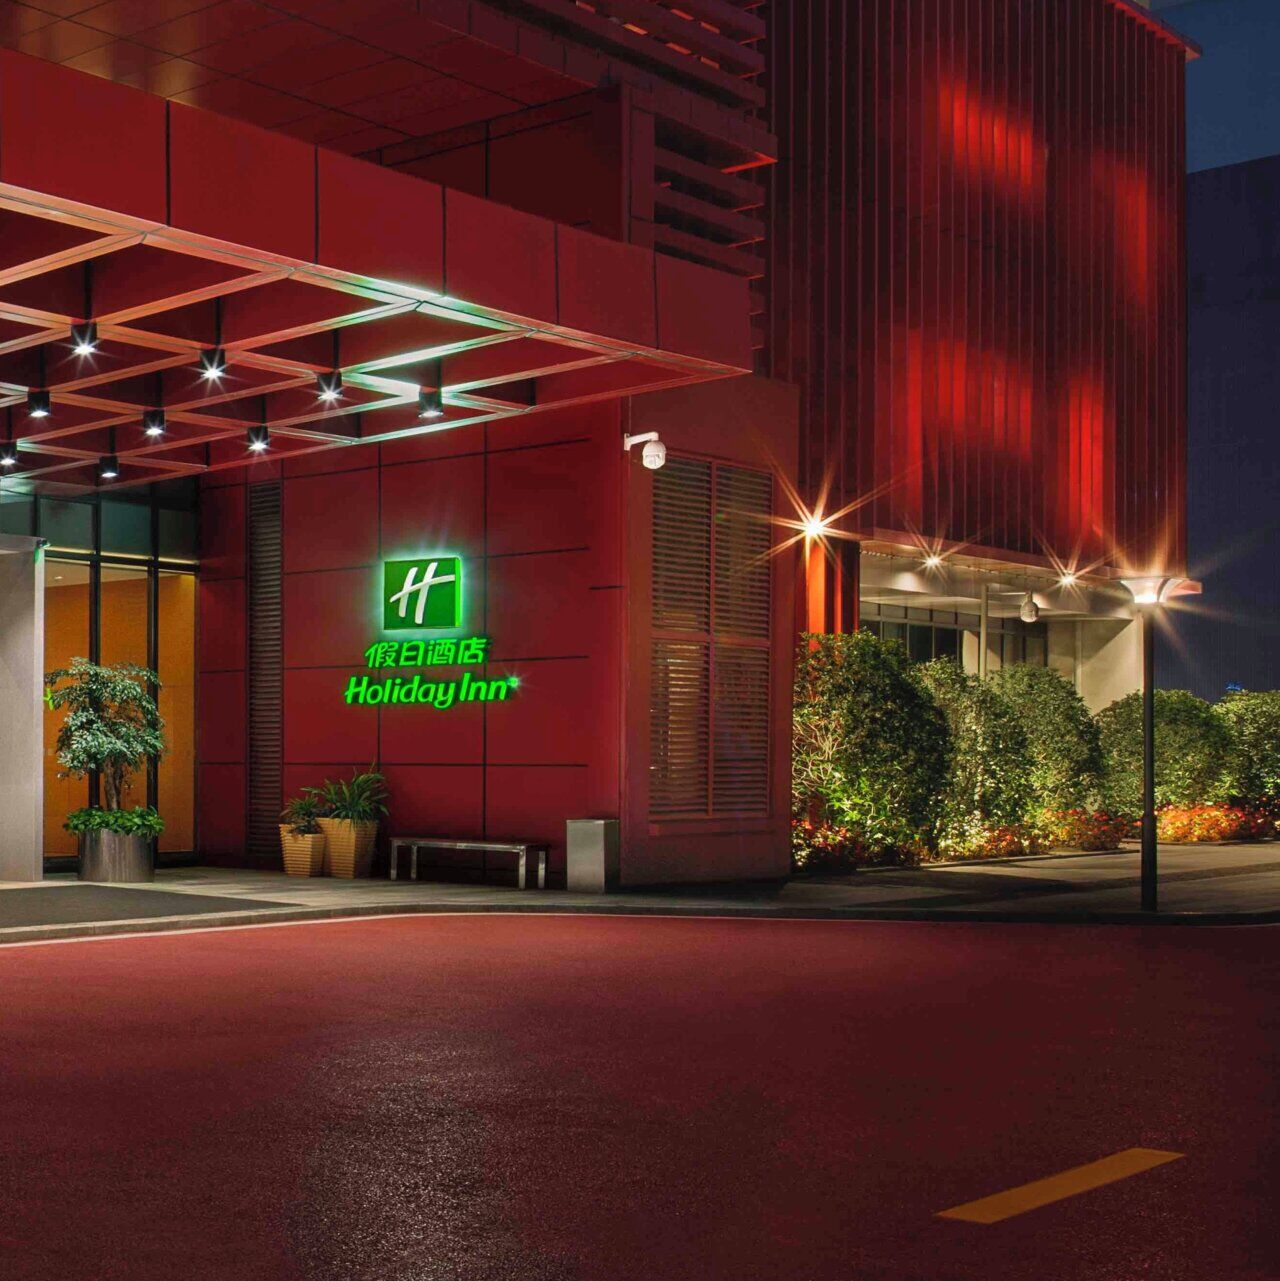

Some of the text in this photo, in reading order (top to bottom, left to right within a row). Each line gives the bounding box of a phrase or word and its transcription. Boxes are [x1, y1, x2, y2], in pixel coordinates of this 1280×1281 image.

[365, 637, 487, 668] 假日酒店
[344, 672, 507, 708] Holiday Inn
